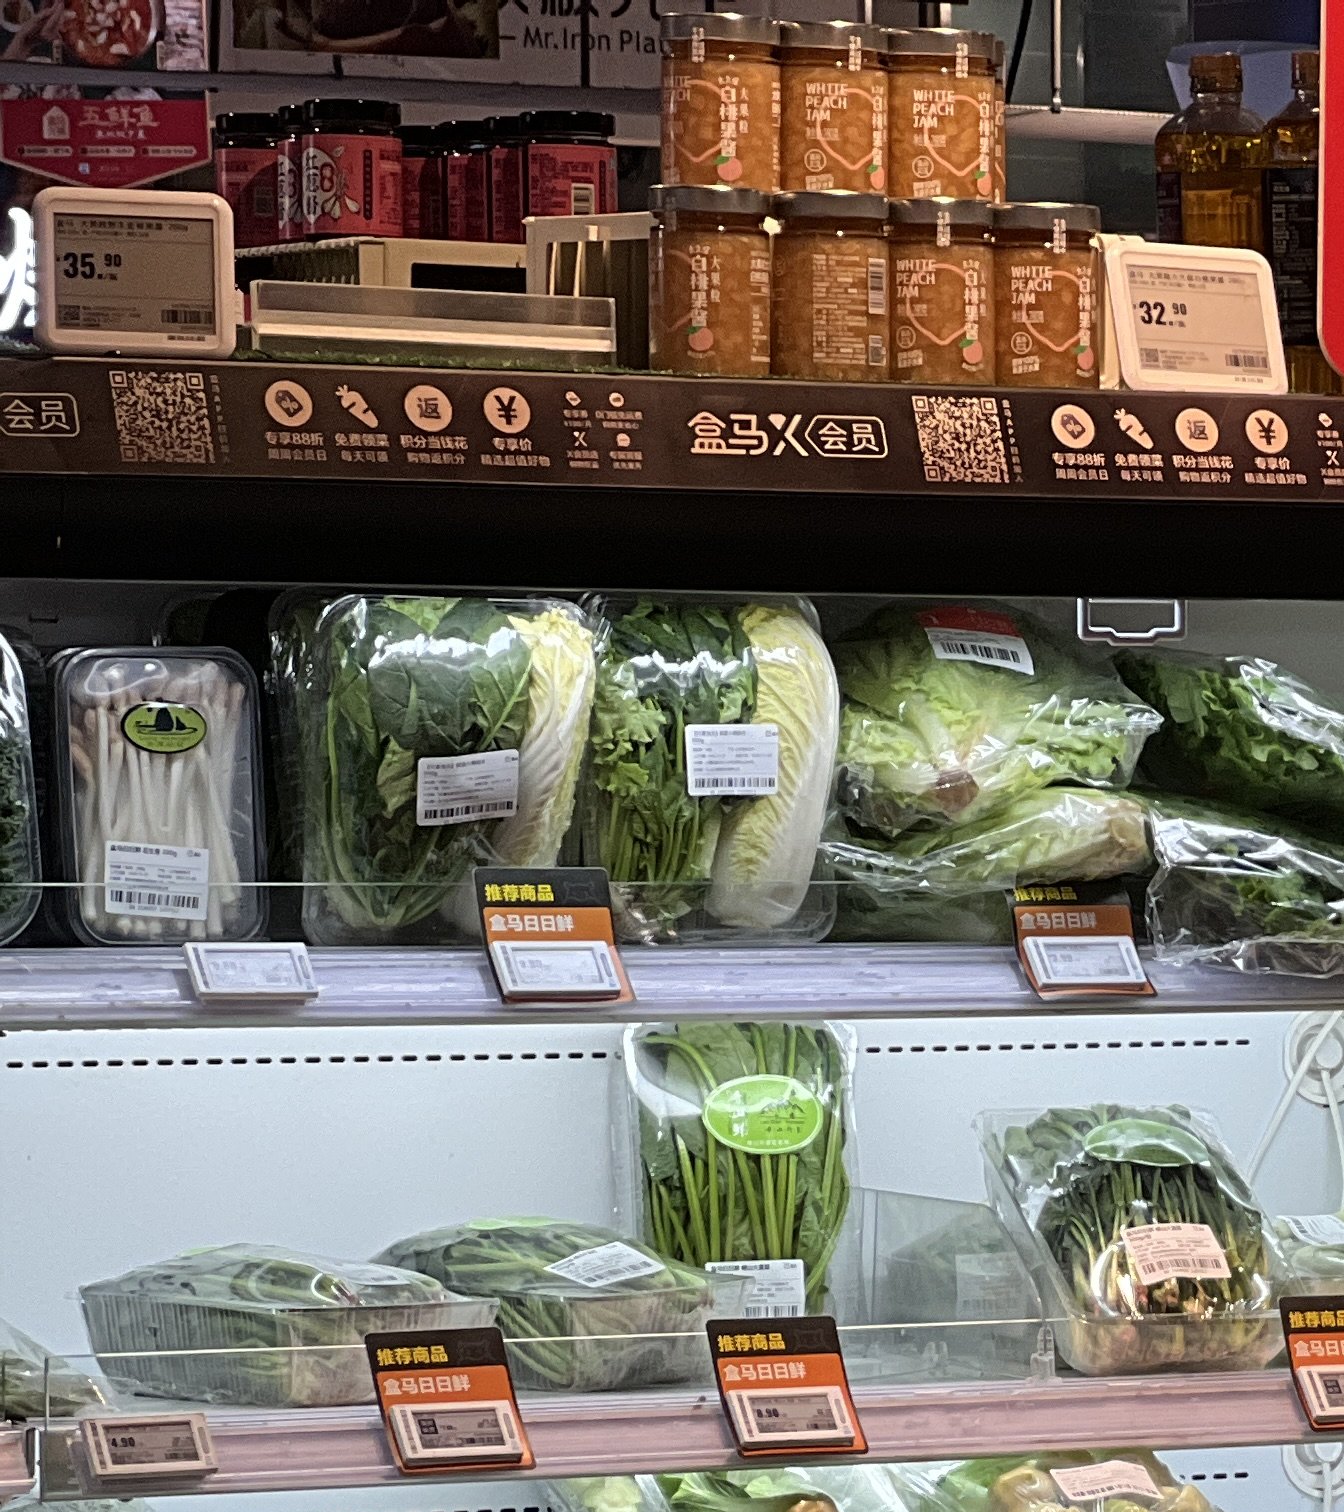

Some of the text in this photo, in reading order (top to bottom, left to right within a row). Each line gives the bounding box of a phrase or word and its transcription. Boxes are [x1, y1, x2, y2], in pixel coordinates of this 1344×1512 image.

[805, 82, 848, 96] WHITE
[912, 89, 954, 102] WHITE
[805, 95, 847, 109] PEACH
[912, 102, 954, 115] PEACH
[896, 259, 936, 271] WHITE
[1011, 266, 1052, 278] WHITE
[896, 272, 936, 285] PEACH
[1011, 279, 1052, 292] PEACH
[3, 399, 70, 430] 会员
[485, 882, 555, 903] 推荐商品
[489, 913, 575, 934] 盒马日日鲜
[1019, 910, 1098, 931] 盒马日日鲜
[717, 1332, 785, 1353] 推荐商品
[377, 1344, 449, 1367] 推荐商品
[723, 1360, 807, 1382] 盒马日日鲜
[383, 1373, 471, 1396] 盒马日日鲜
[111, 1436, 136, 1449] 4.90
